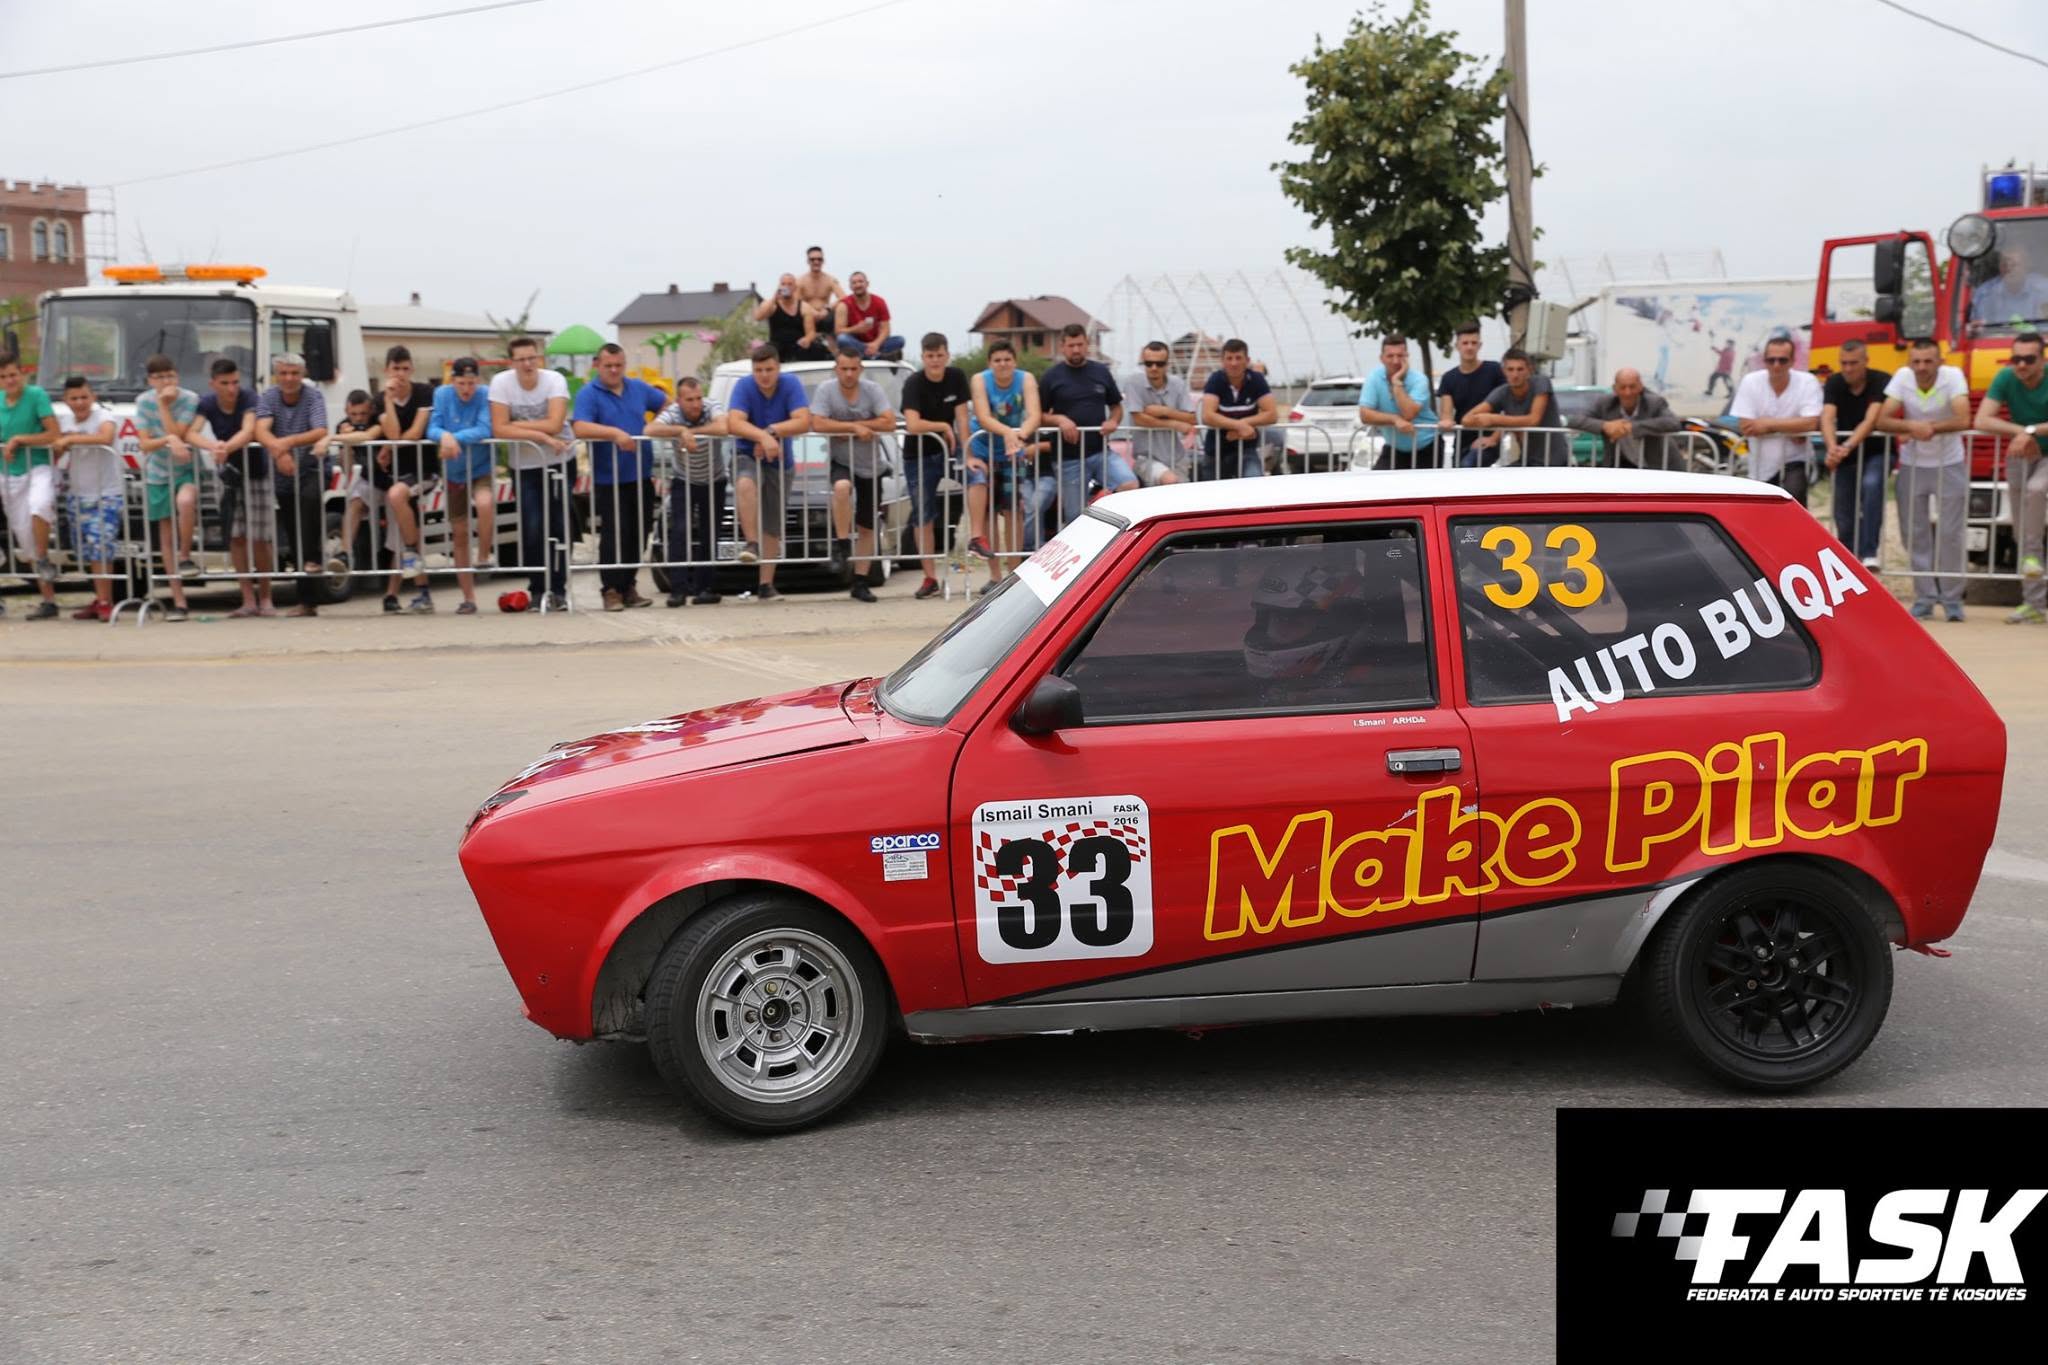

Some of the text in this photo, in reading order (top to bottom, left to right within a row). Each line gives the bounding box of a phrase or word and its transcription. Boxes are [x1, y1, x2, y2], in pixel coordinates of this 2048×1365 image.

[1480, 524, 1606, 609] 33
[1547, 547, 1868, 723] AUTO BUQA
[980, 801, 1093, 823] Ismail Smani
[1113, 803, 1141, 813] FASK
[1113, 817, 1139, 826] 2016
[871, 833, 940, 853] sparco
[1204, 732, 1928, 941] Make Pilar
[995, 835, 1134, 950] 33
